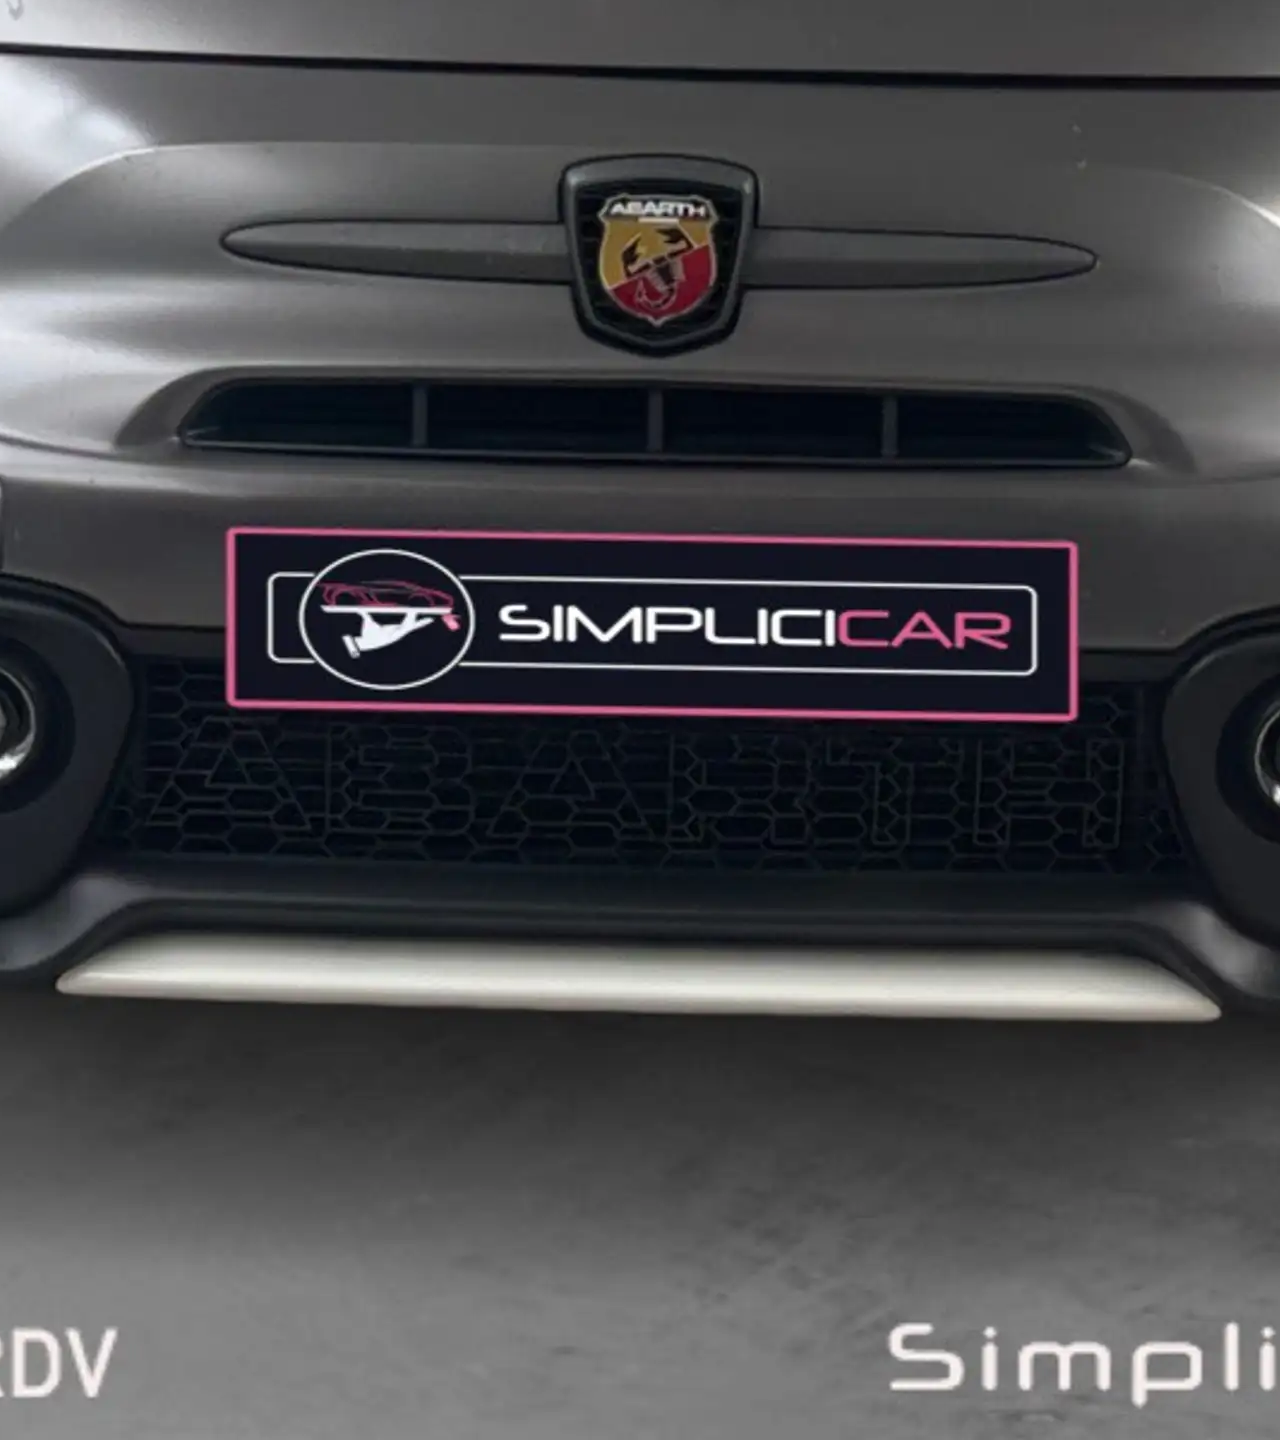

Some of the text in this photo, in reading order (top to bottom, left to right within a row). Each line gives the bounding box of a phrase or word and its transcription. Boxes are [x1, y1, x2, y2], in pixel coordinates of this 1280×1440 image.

[609, 200, 707, 217] ABARTH
[498, 603, 1012, 650] SIMPLICICAR
[143, 713, 1124, 847] ABARTH
